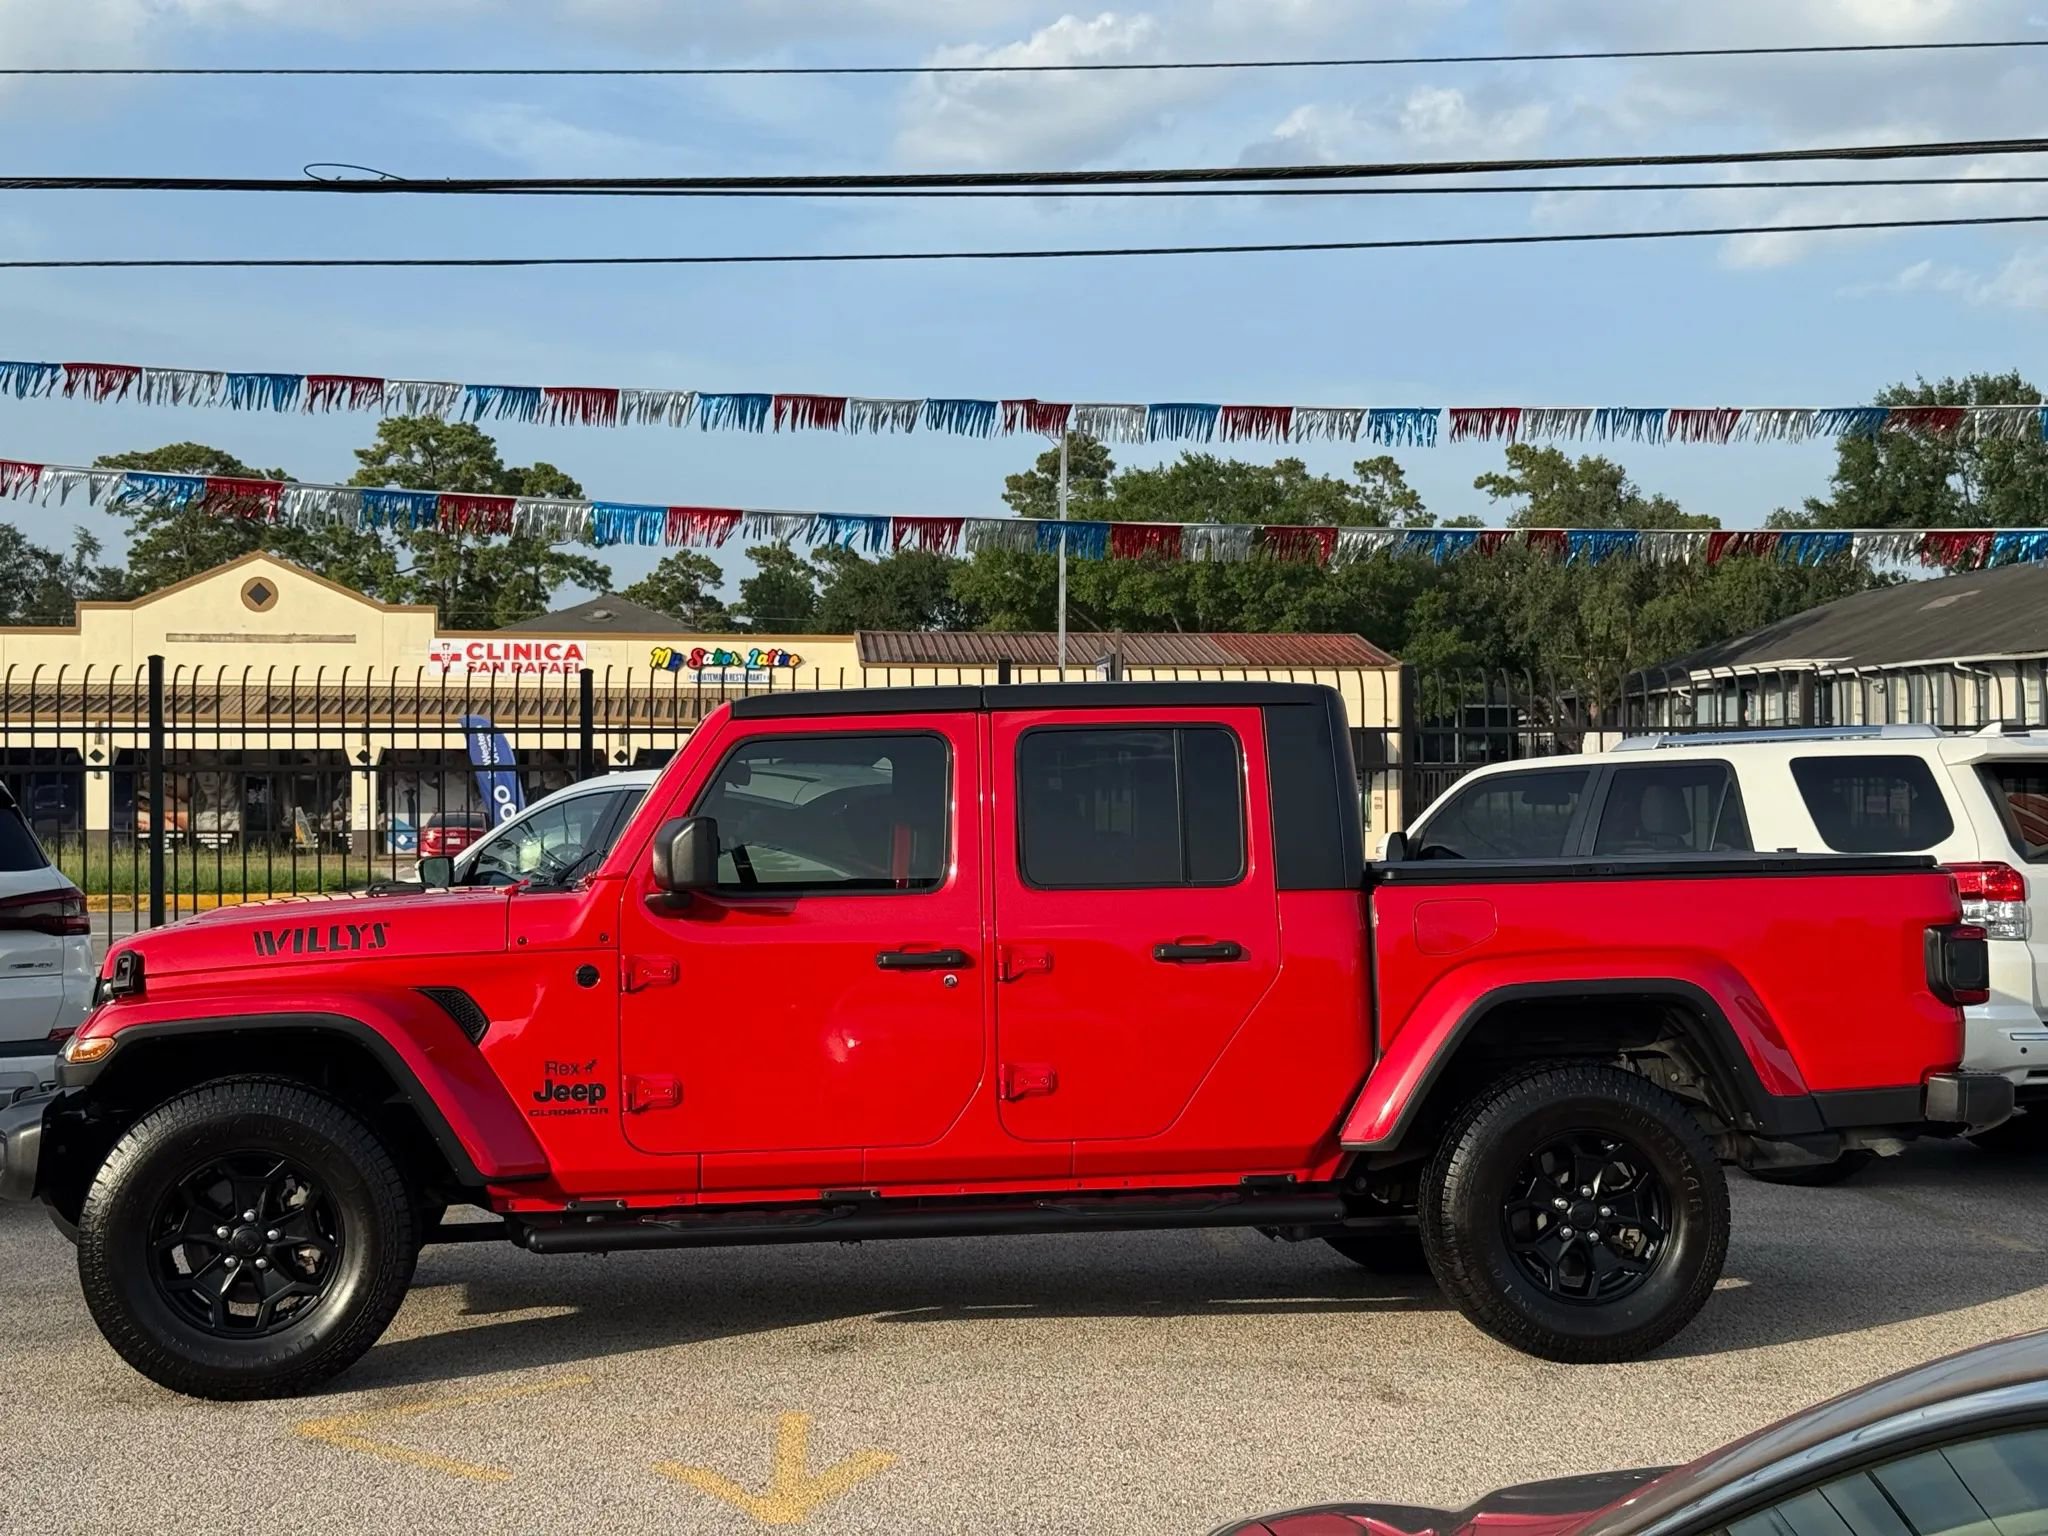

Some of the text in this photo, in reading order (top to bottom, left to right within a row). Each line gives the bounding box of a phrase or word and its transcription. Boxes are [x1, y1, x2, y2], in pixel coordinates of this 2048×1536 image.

[466, 642, 584, 660] CLINICA
[686, 647, 741, 669] Sabor
[745, 647, 802, 669] Latino
[466, 661, 581, 674] SAN RAFAEL
[729, 673, 763, 682] RESTARANT
[253, 922, 391, 956] WILLYS
[544, 1060, 580, 1075] Rex
[533, 1079, 606, 1105] Jeep
